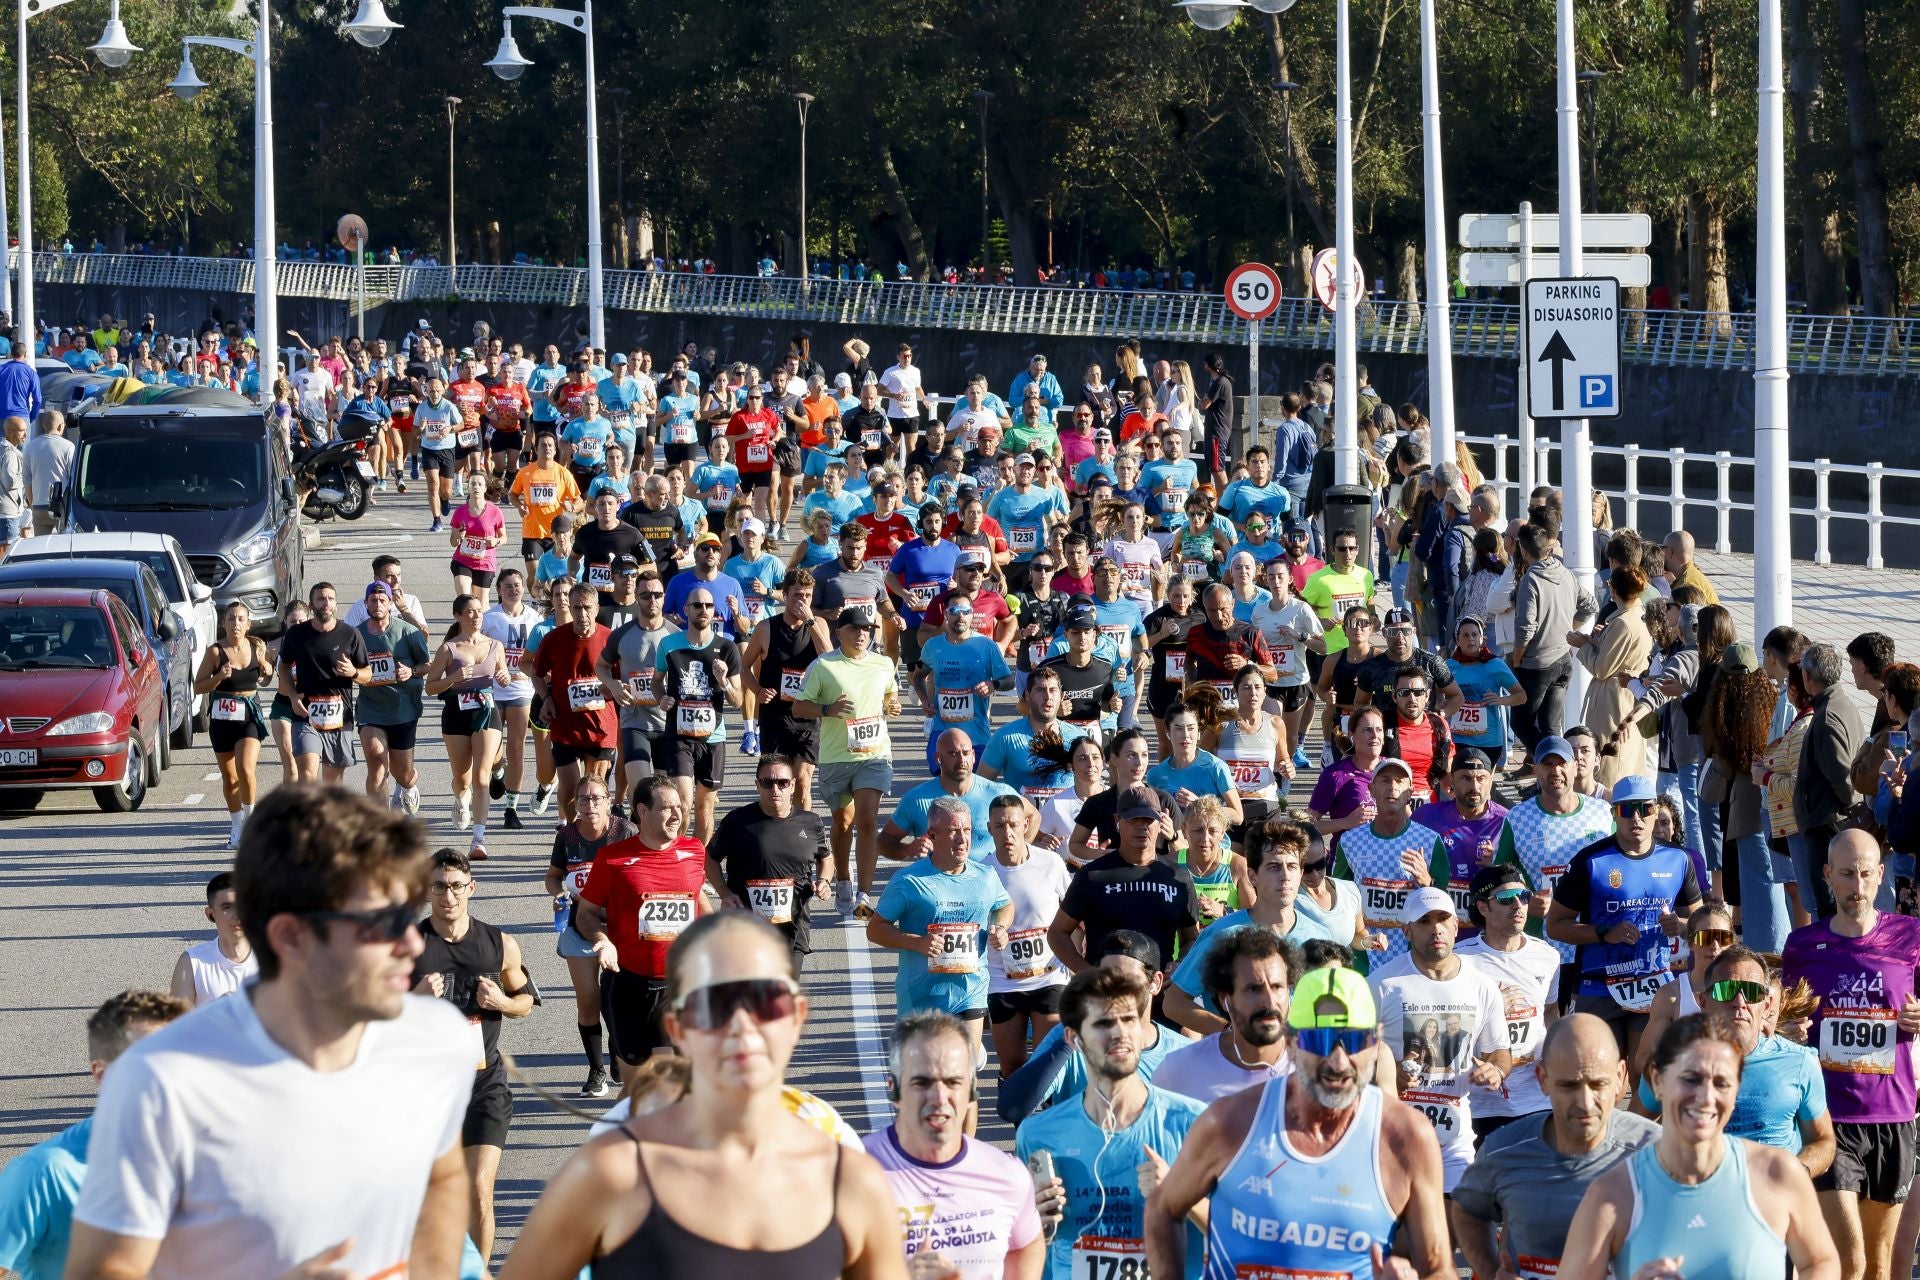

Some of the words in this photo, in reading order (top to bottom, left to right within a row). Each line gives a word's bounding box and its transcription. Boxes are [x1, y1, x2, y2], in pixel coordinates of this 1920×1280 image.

[1237, 282, 1269, 300] 50
[1545, 285, 1601, 299] PARKING
[1534, 307, 1614, 322] DISUASORIO
[1586, 378, 1606, 403] P
[533, 487, 554, 498] 1706
[1168, 494, 1183, 504] 971
[466, 538, 481, 550] 798
[1014, 532, 1034, 542] 1238
[311, 703, 340, 717] 2457
[943, 696, 970, 710] 2071
[682, 708, 711, 723] 1343
[1459, 708, 1480, 723] 725
[852, 723, 881, 741] 1697
[1234, 768, 1261, 784] 702
[753, 888, 788, 906] 2413
[1367, 889, 1408, 910] 1505
[645, 902, 689, 922] 2329
[1010, 938, 1044, 961] 990
[1605, 958, 1645, 976] RUNNING
[1615, 978, 1661, 1002] 1749
[1851, 970, 1884, 998] 44
[1831, 1021, 1887, 1048] 1690
[1096, 1186, 1131, 1198] MBA
[1238, 1175, 1273, 1198] AXA
[1089, 1202, 1132, 1213] media
[907, 1219, 930, 1228] MEDIA
[1231, 1207, 1372, 1252] RIBADEO
[907, 1227, 939, 1241] RUTA
[961, 1224, 974, 1233] LA
[906, 1230, 997, 1255] REONQUISTA
[1104, 1242, 1123, 1250] MBA
